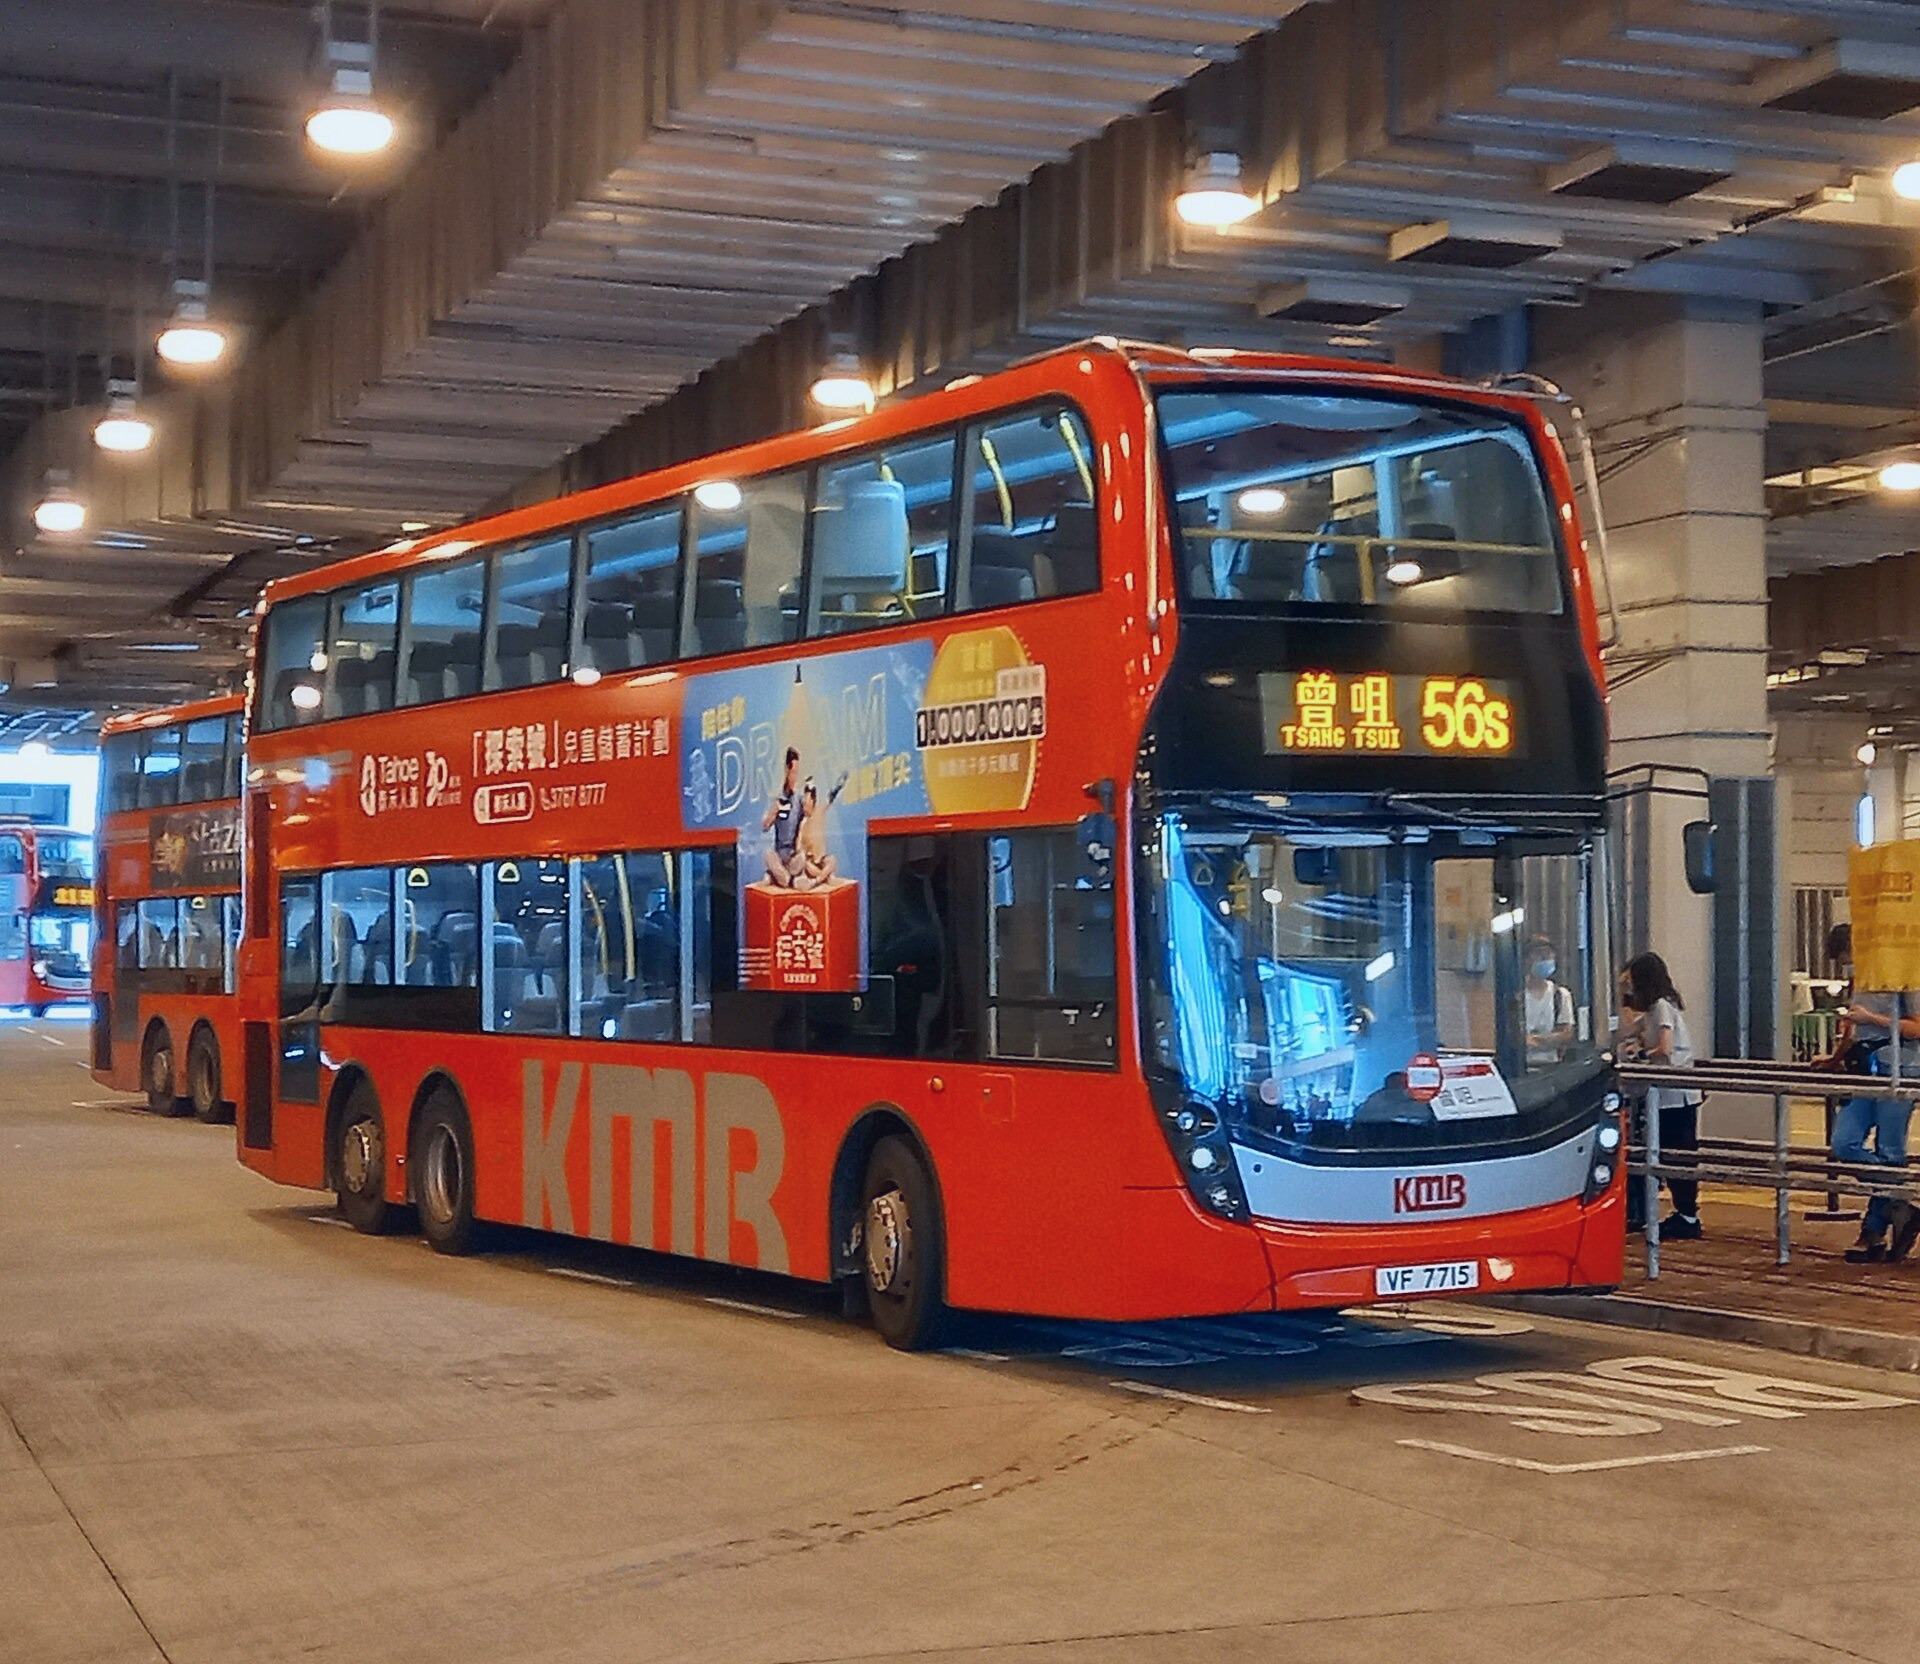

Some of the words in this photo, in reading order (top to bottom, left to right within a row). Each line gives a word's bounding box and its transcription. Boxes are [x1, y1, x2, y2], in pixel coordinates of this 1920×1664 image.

[1295, 672, 1394, 728] 曾咀
[1281, 725, 1345, 748] TSANG
[1351, 726, 1401, 749] TSUI
[378, 755, 419, 784] Tahoe
[522, 1059, 791, 1275] KMB
[1393, 1173, 1467, 1214] KMB
[1386, 1269, 1413, 1291] VF
[1424, 1265, 1471, 1288] 7715
